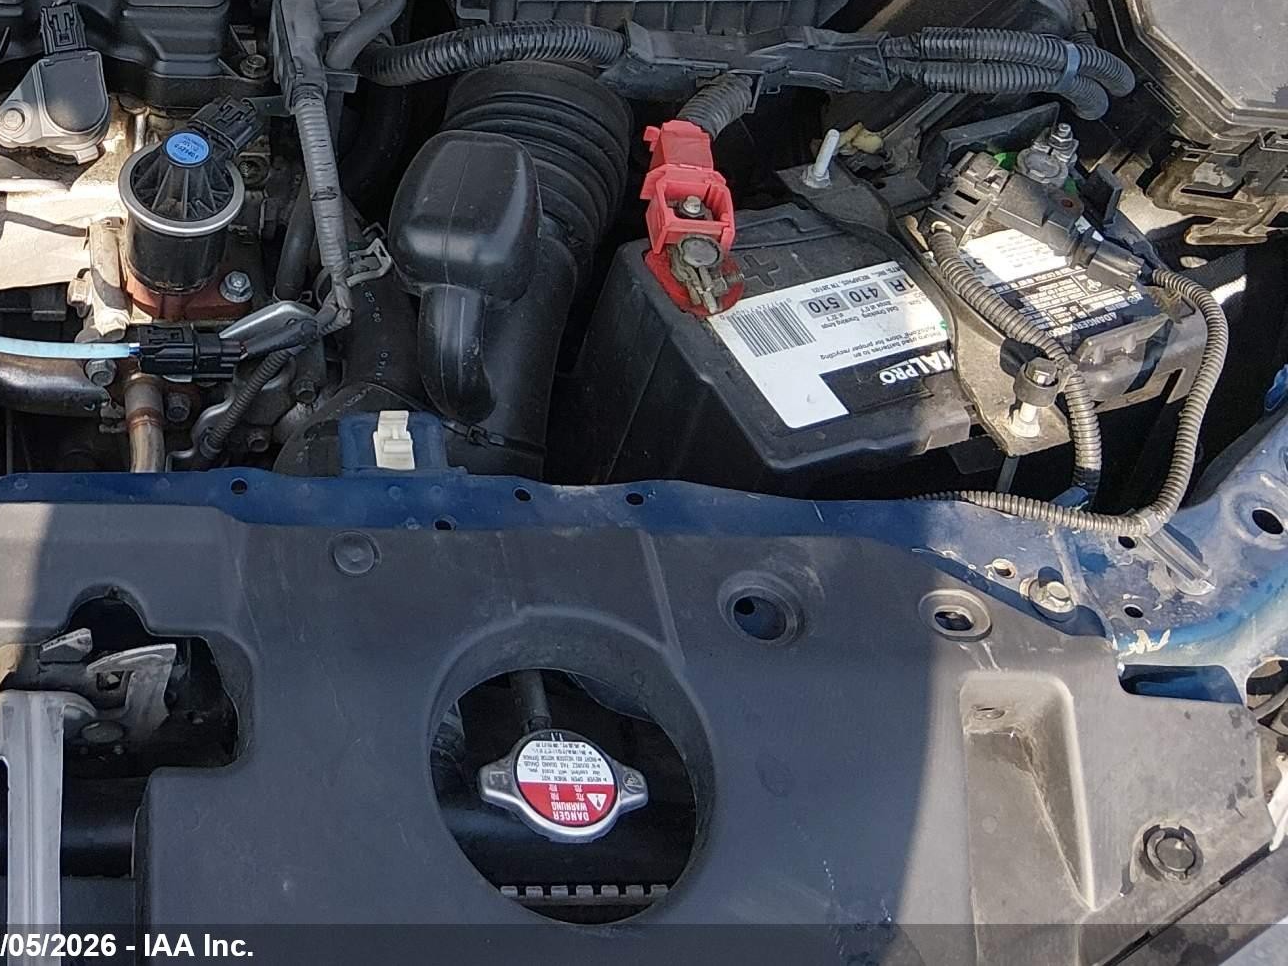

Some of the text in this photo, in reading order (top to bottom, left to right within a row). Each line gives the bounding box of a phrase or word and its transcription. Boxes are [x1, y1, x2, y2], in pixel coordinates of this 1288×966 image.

[848, 286, 879, 303] 410
[808, 297, 841, 314] 510
[852, 340, 874, 351] proper
[872, 340, 901, 352] batteries
[820, 347, 851, 360] recycling
[552, 811, 590, 821] DANGER
